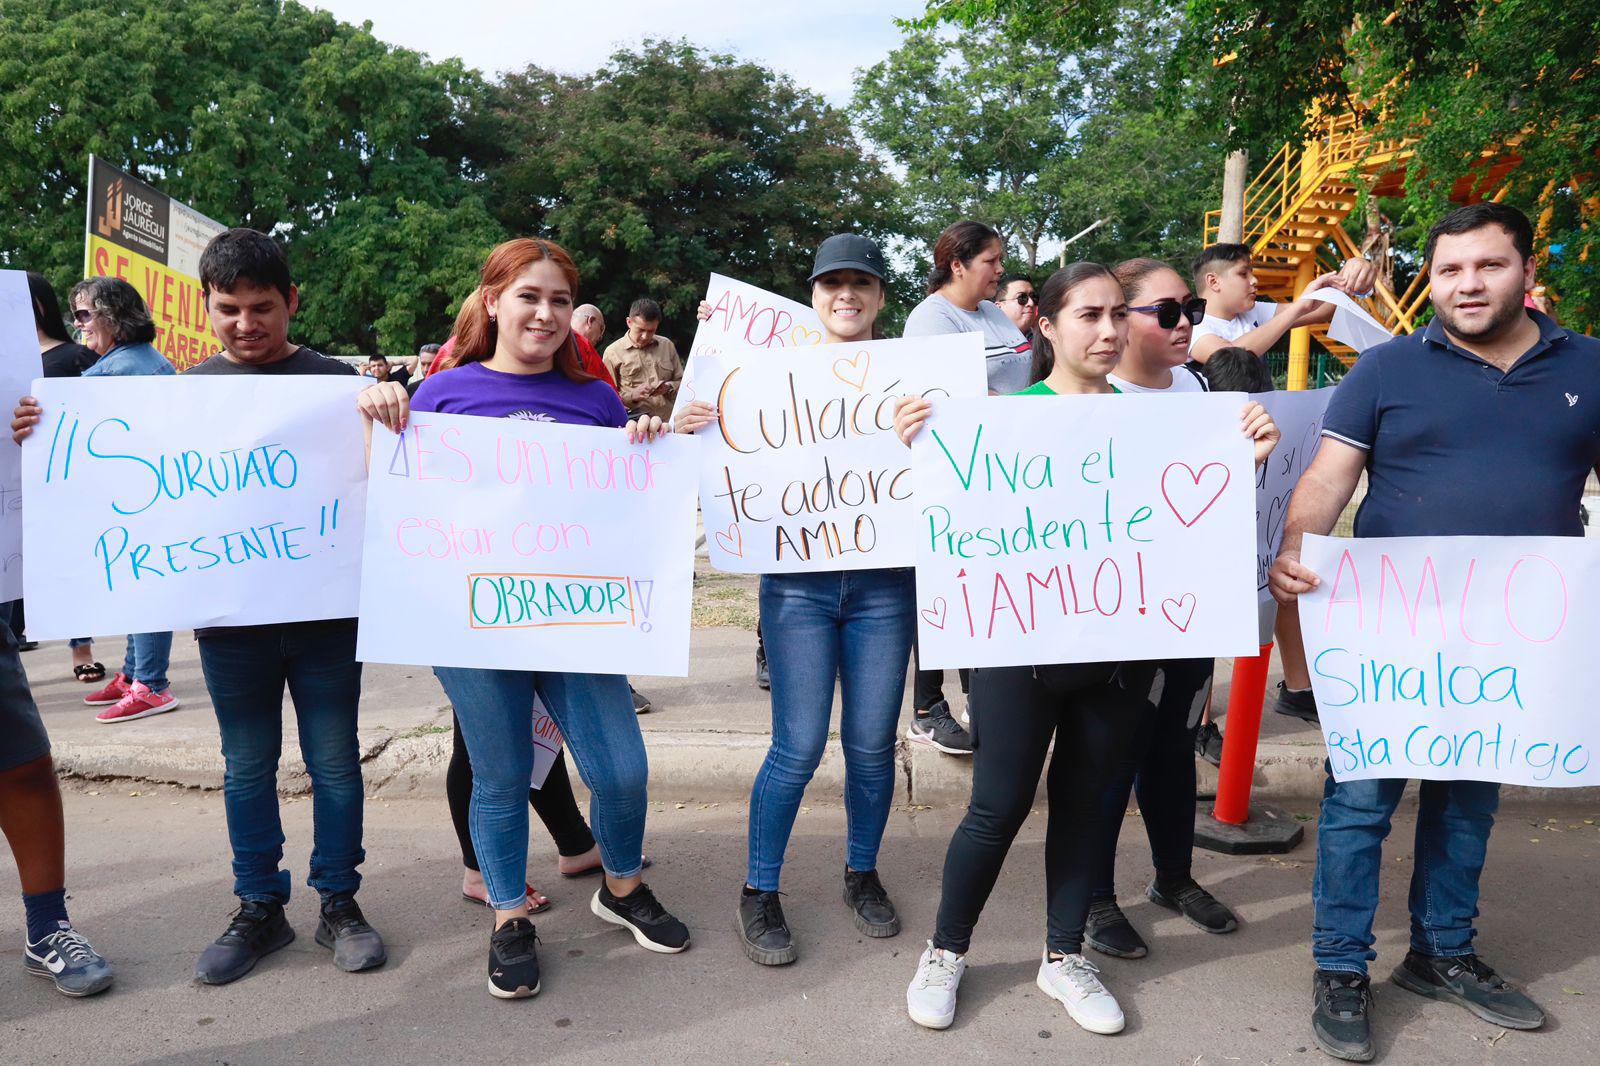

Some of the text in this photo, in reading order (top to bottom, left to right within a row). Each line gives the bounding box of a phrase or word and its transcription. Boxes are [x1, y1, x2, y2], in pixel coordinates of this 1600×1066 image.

[123, 193, 153, 218] JORGE
[145, 267, 217, 338] VEND
[706, 290, 792, 348] AMOR
[931, 424, 1115, 493] Viva el
[714, 466, 773, 523] te
[922, 489, 1155, 560] Presidente
[396, 517, 591, 560] estar con
[776, 513, 877, 562] AMLO
[956, 552, 1148, 639] ¡AMLO!
[1324, 549, 1568, 646] AMLO
[1314, 648, 1524, 711] Sinaloa
